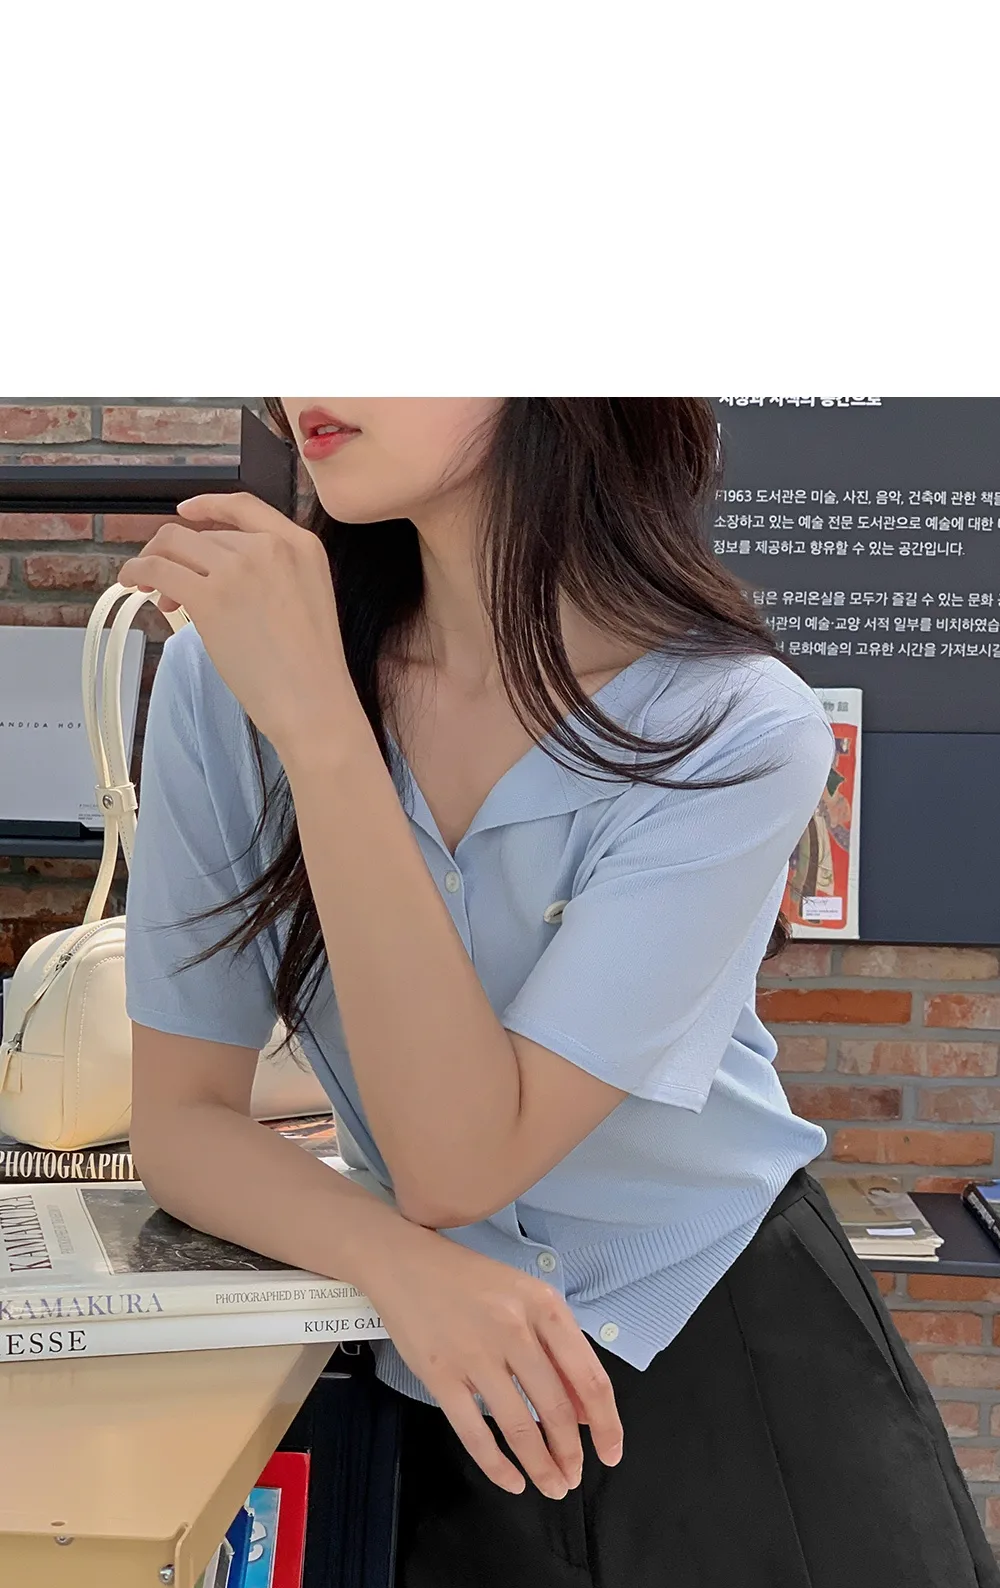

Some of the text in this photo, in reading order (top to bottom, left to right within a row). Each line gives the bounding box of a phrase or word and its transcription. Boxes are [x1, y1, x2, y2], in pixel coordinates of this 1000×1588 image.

[756, 489, 808, 504] 도서관은
[811, 489, 839, 505] 미술,
[843, 489, 871, 505] 사진,
[876, 490, 904, 506] 음악,
[908, 490, 947, 506] 건축에
[951, 491, 976, 506] 관한
[714, 514, 765, 529] 소장하고
[769, 514, 795, 530] 있는
[798, 515, 824, 530] 예술
[828, 515, 853, 530] 전문
[857, 515, 921, 531] 도서관으로
[925, 516, 964, 531] 예술에
[968, 516, 994, 532] 대한
[714, 540, 966, 557] 정보를 제공하고 향유할 수 있는 공간입니다.
[782, 590, 846, 606] 유리온실을
[849, 591, 888, 607] 모두가
[892, 592, 917, 607] 즐길
[921, 592, 934, 607] 수
[938, 592, 964, 607] 있는
[968, 593, 994, 608] 문화
[864, 616, 889, 632] 서적
[894, 617, 932, 632] 일부를
[788, 641, 852, 656] 문화예술의
[856, 642, 894, 657] 고유한
[898, 642, 936, 657] 시간을
[215, 1290, 292, 1304] PHOTOGRAPHED
[294, 1289, 306, 1300] BY
[308, 1288, 348, 1299] TAKASHI
[304, 1319, 350, 1333] KUKJE
